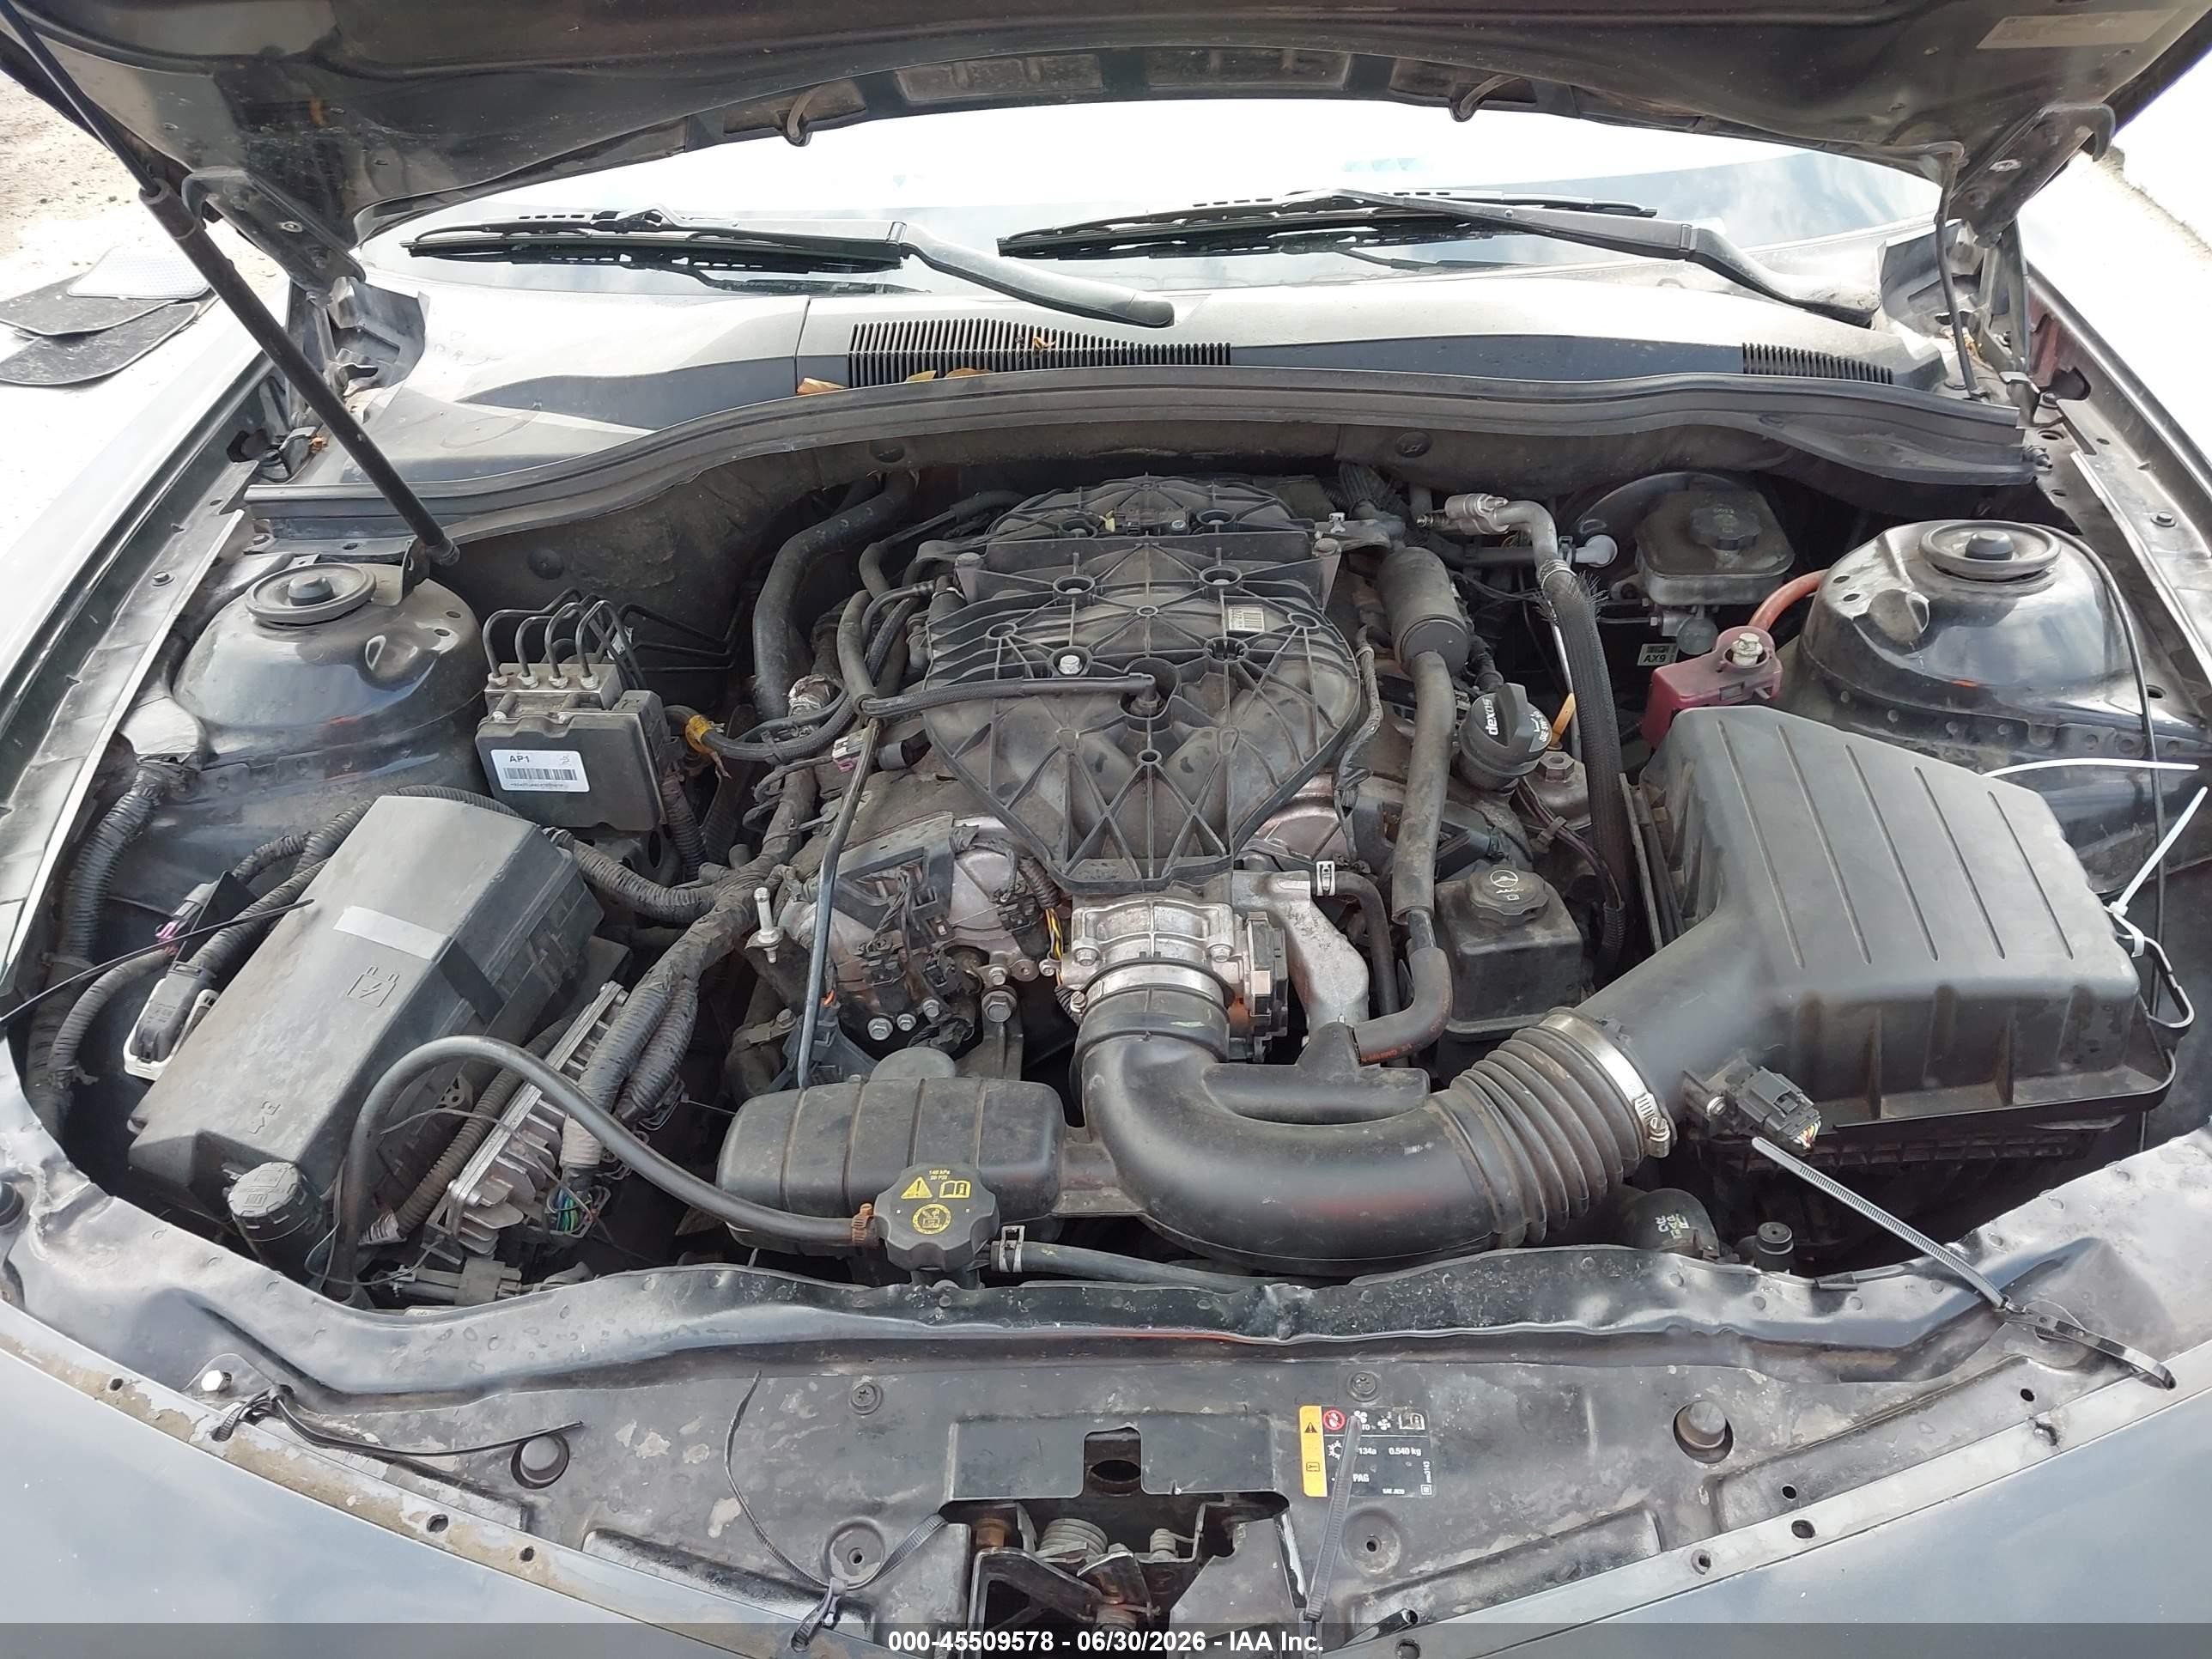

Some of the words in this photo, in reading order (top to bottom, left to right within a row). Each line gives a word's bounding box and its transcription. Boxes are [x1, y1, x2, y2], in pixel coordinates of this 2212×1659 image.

[1643, 654, 1666, 663] AX9
[1482, 697, 1499, 736] dexos
[509, 755, 530, 763] AP1
[1358, 1447, 1377, 1455] 134a
[1389, 1447, 1410, 1455] 0.540
[1411, 1447, 1422, 1456] kg
[1352, 1474, 1370, 1483] PAG
